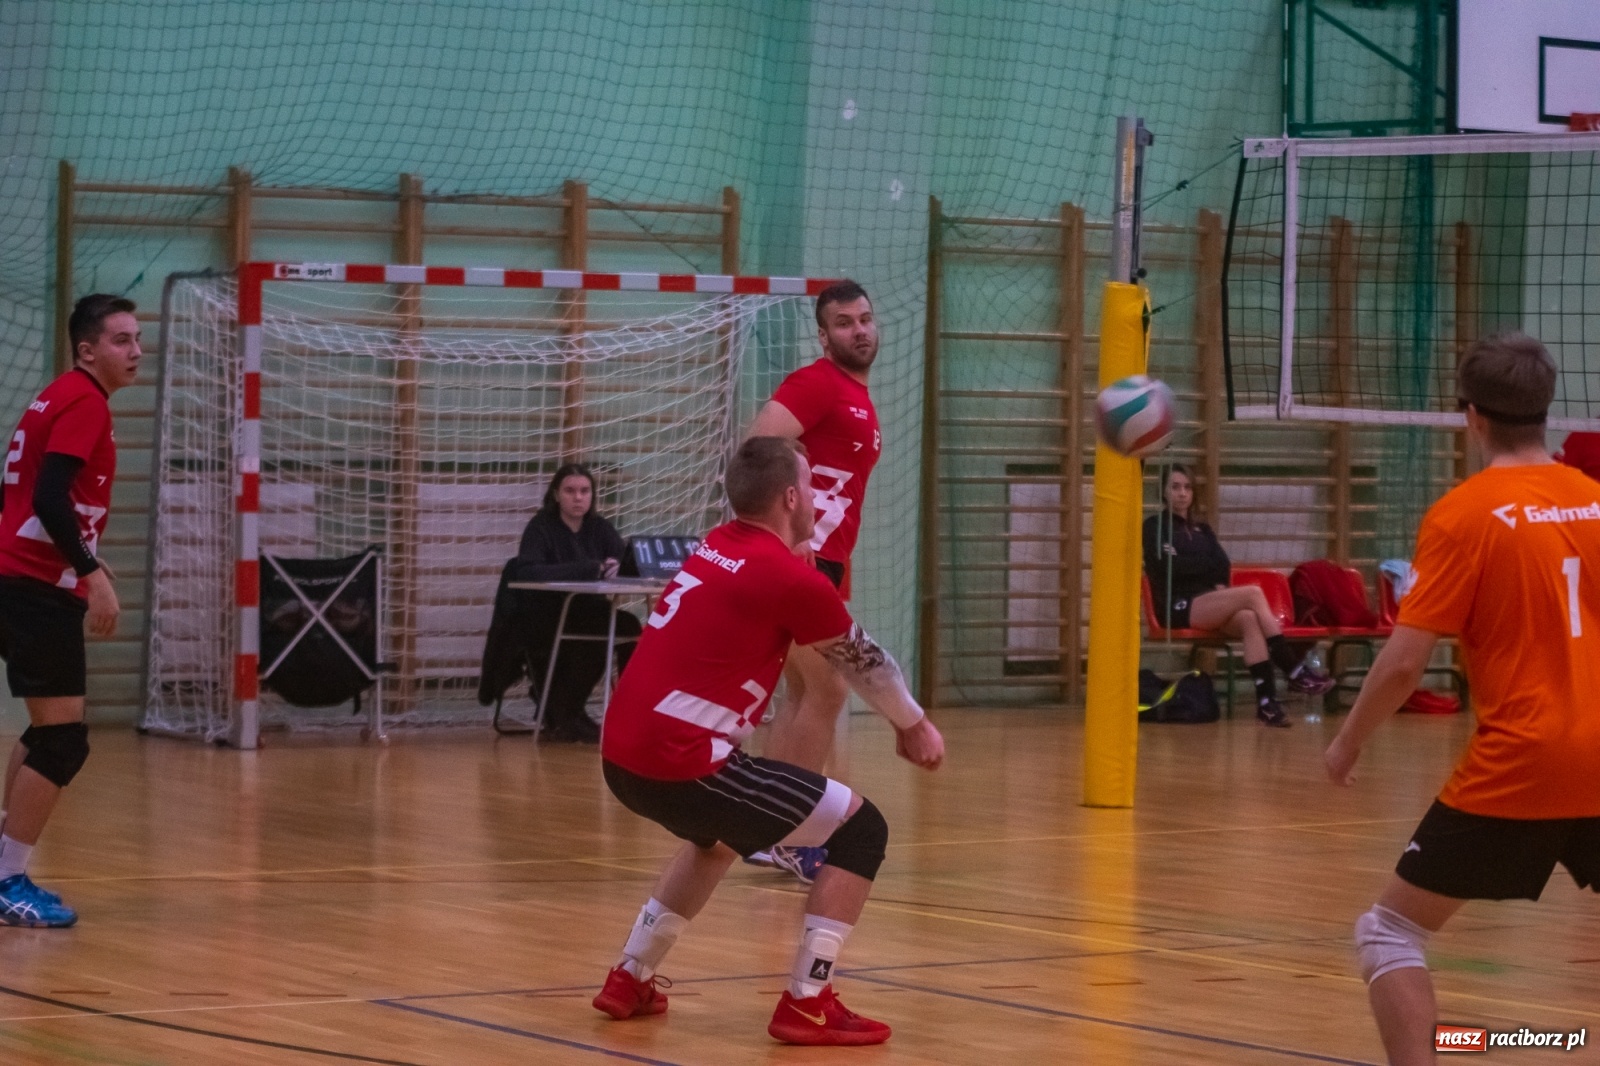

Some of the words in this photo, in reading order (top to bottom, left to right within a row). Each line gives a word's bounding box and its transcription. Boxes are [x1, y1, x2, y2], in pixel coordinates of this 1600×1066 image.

[307, 267, 332, 277] sport
[647, 570, 704, 630] 3
[1561, 556, 1582, 639] 1
